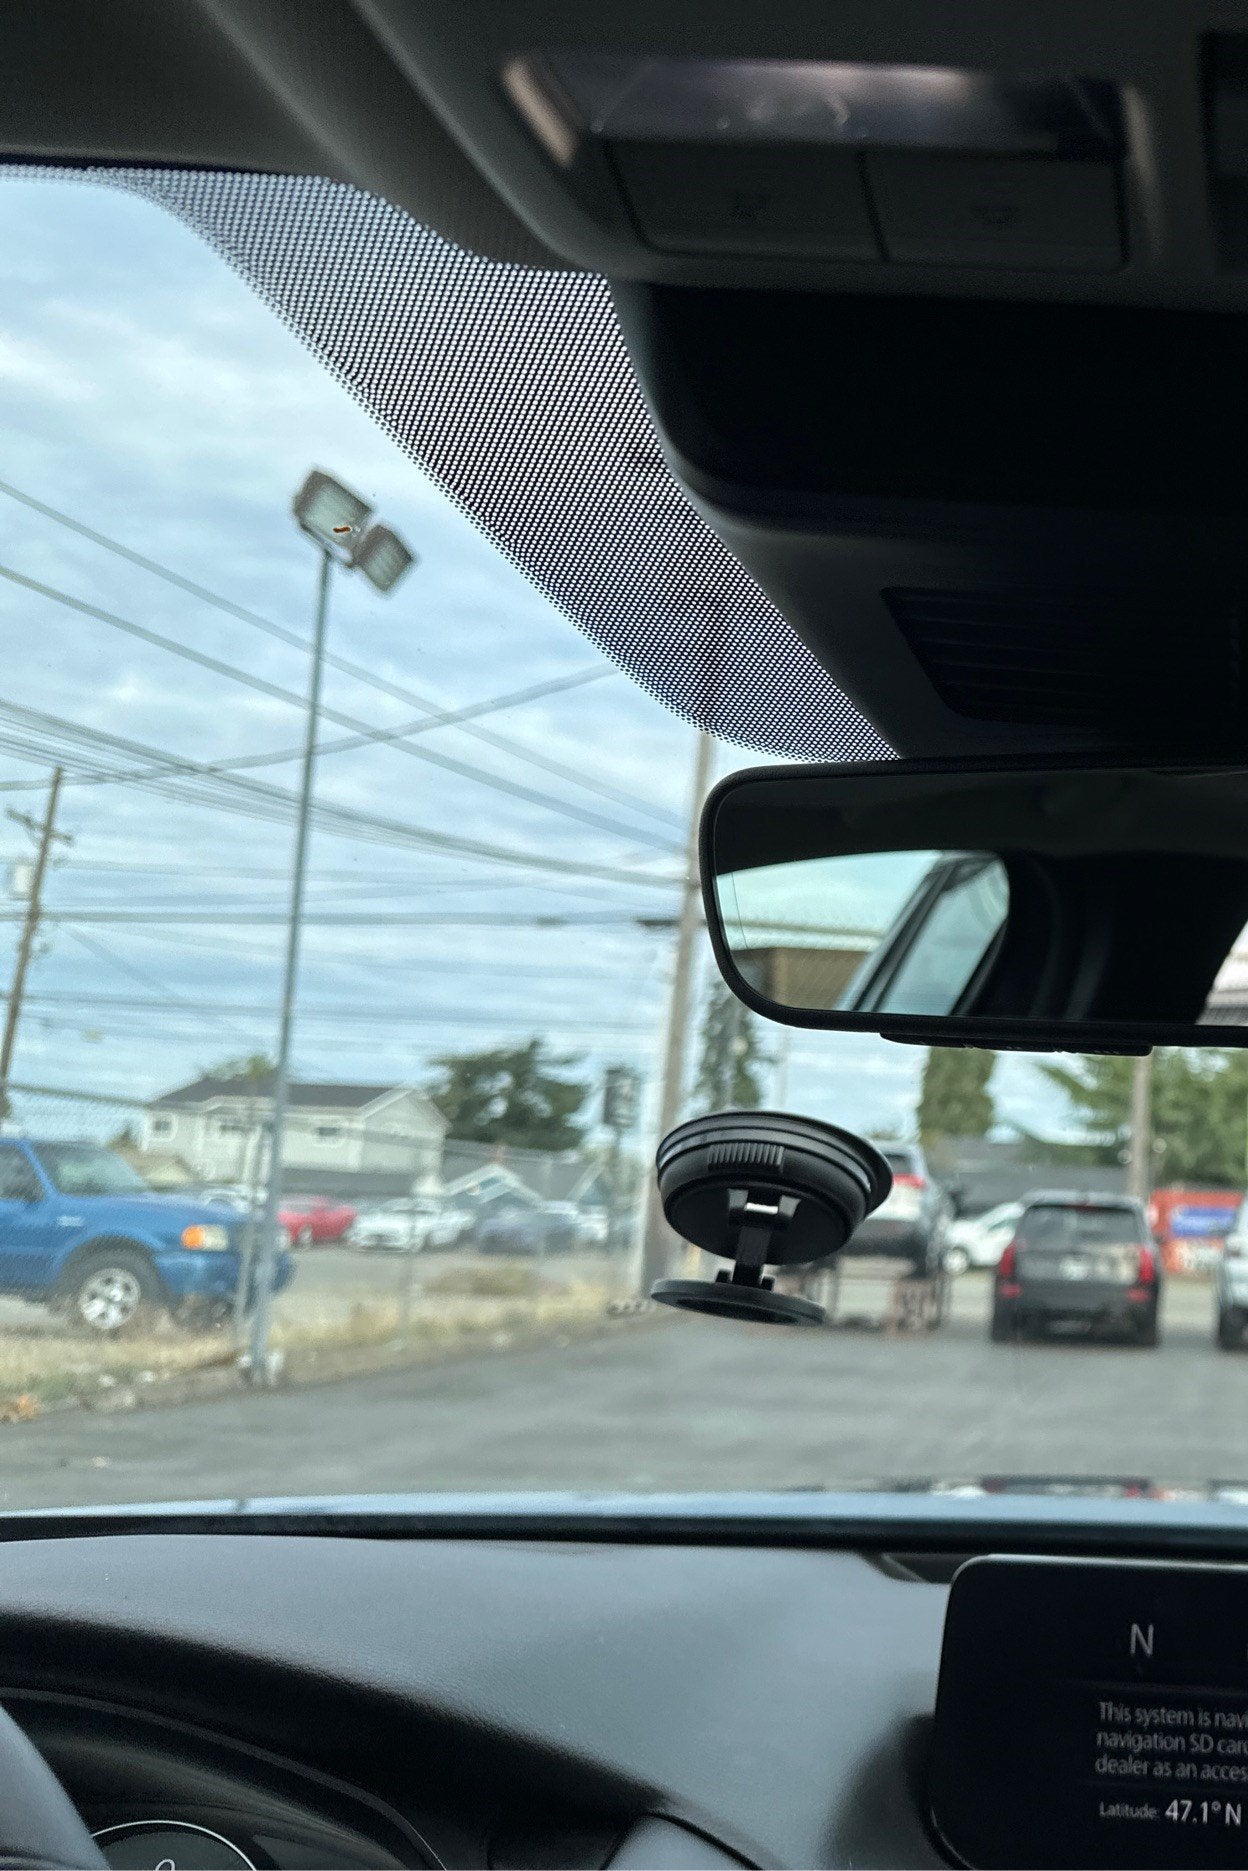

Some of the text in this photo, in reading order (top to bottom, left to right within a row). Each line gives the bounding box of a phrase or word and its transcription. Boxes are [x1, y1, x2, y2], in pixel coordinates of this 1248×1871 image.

[1129, 1623, 1155, 1657] N
[1099, 1702, 1131, 1722] This
[1135, 1706, 1194, 1728] system
[1198, 1709, 1211, 1726] is
[1096, 1731, 1185, 1753] navigation
[1189, 1734, 1213, 1753] SD
[1095, 1756, 1148, 1776] dealer
[1152, 1762, 1171, 1778] as
[1175, 1763, 1197, 1779] an
